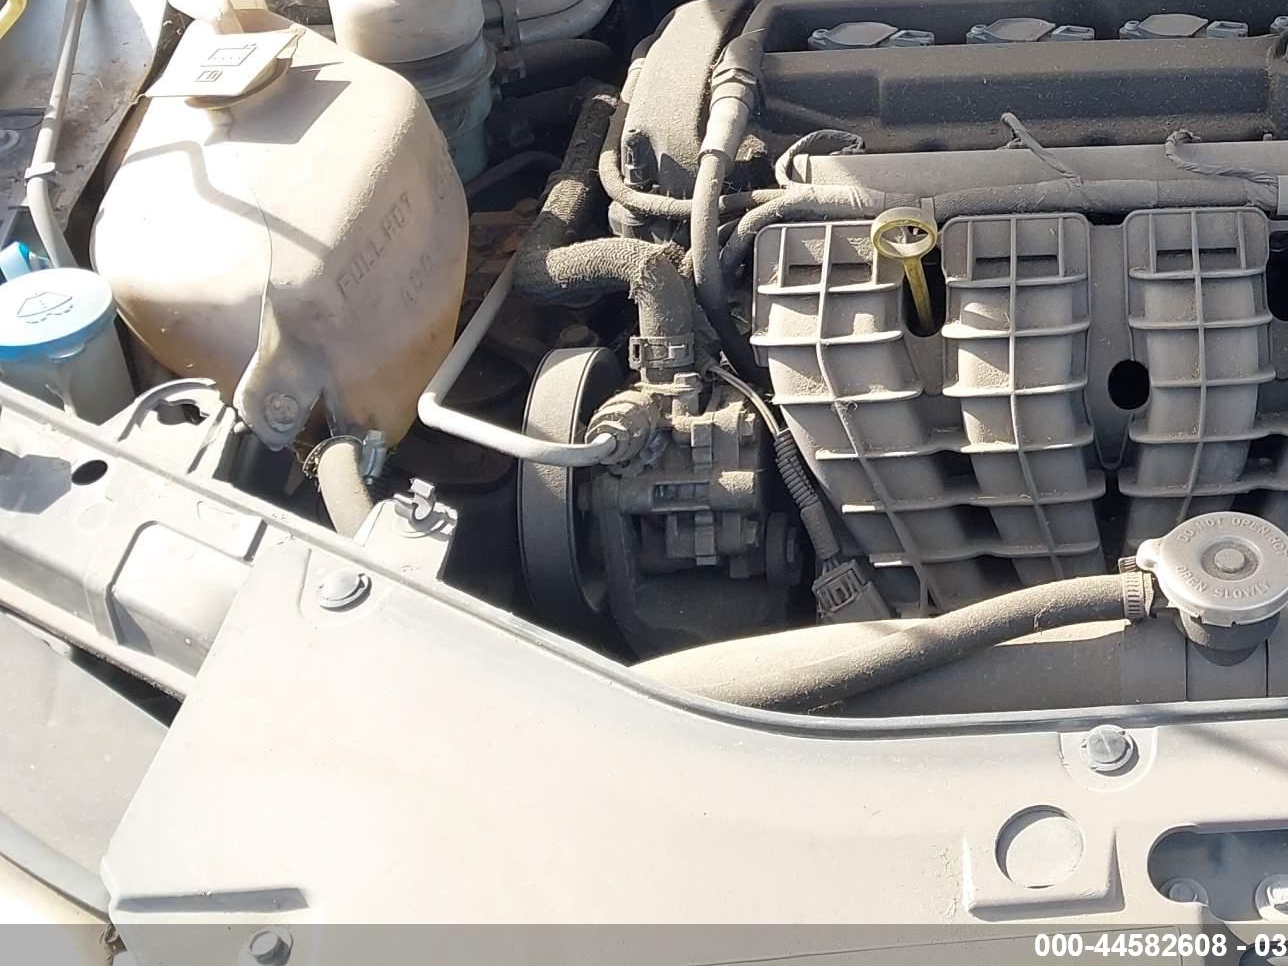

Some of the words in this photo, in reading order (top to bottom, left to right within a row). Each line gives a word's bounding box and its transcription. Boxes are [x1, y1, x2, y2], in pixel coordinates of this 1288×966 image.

[336, 239, 385, 300] FULL
[1231, 516, 1269, 536] OPEN
[1176, 564, 1208, 594] OPEN
[1214, 580, 1271, 599] SLOWLY
